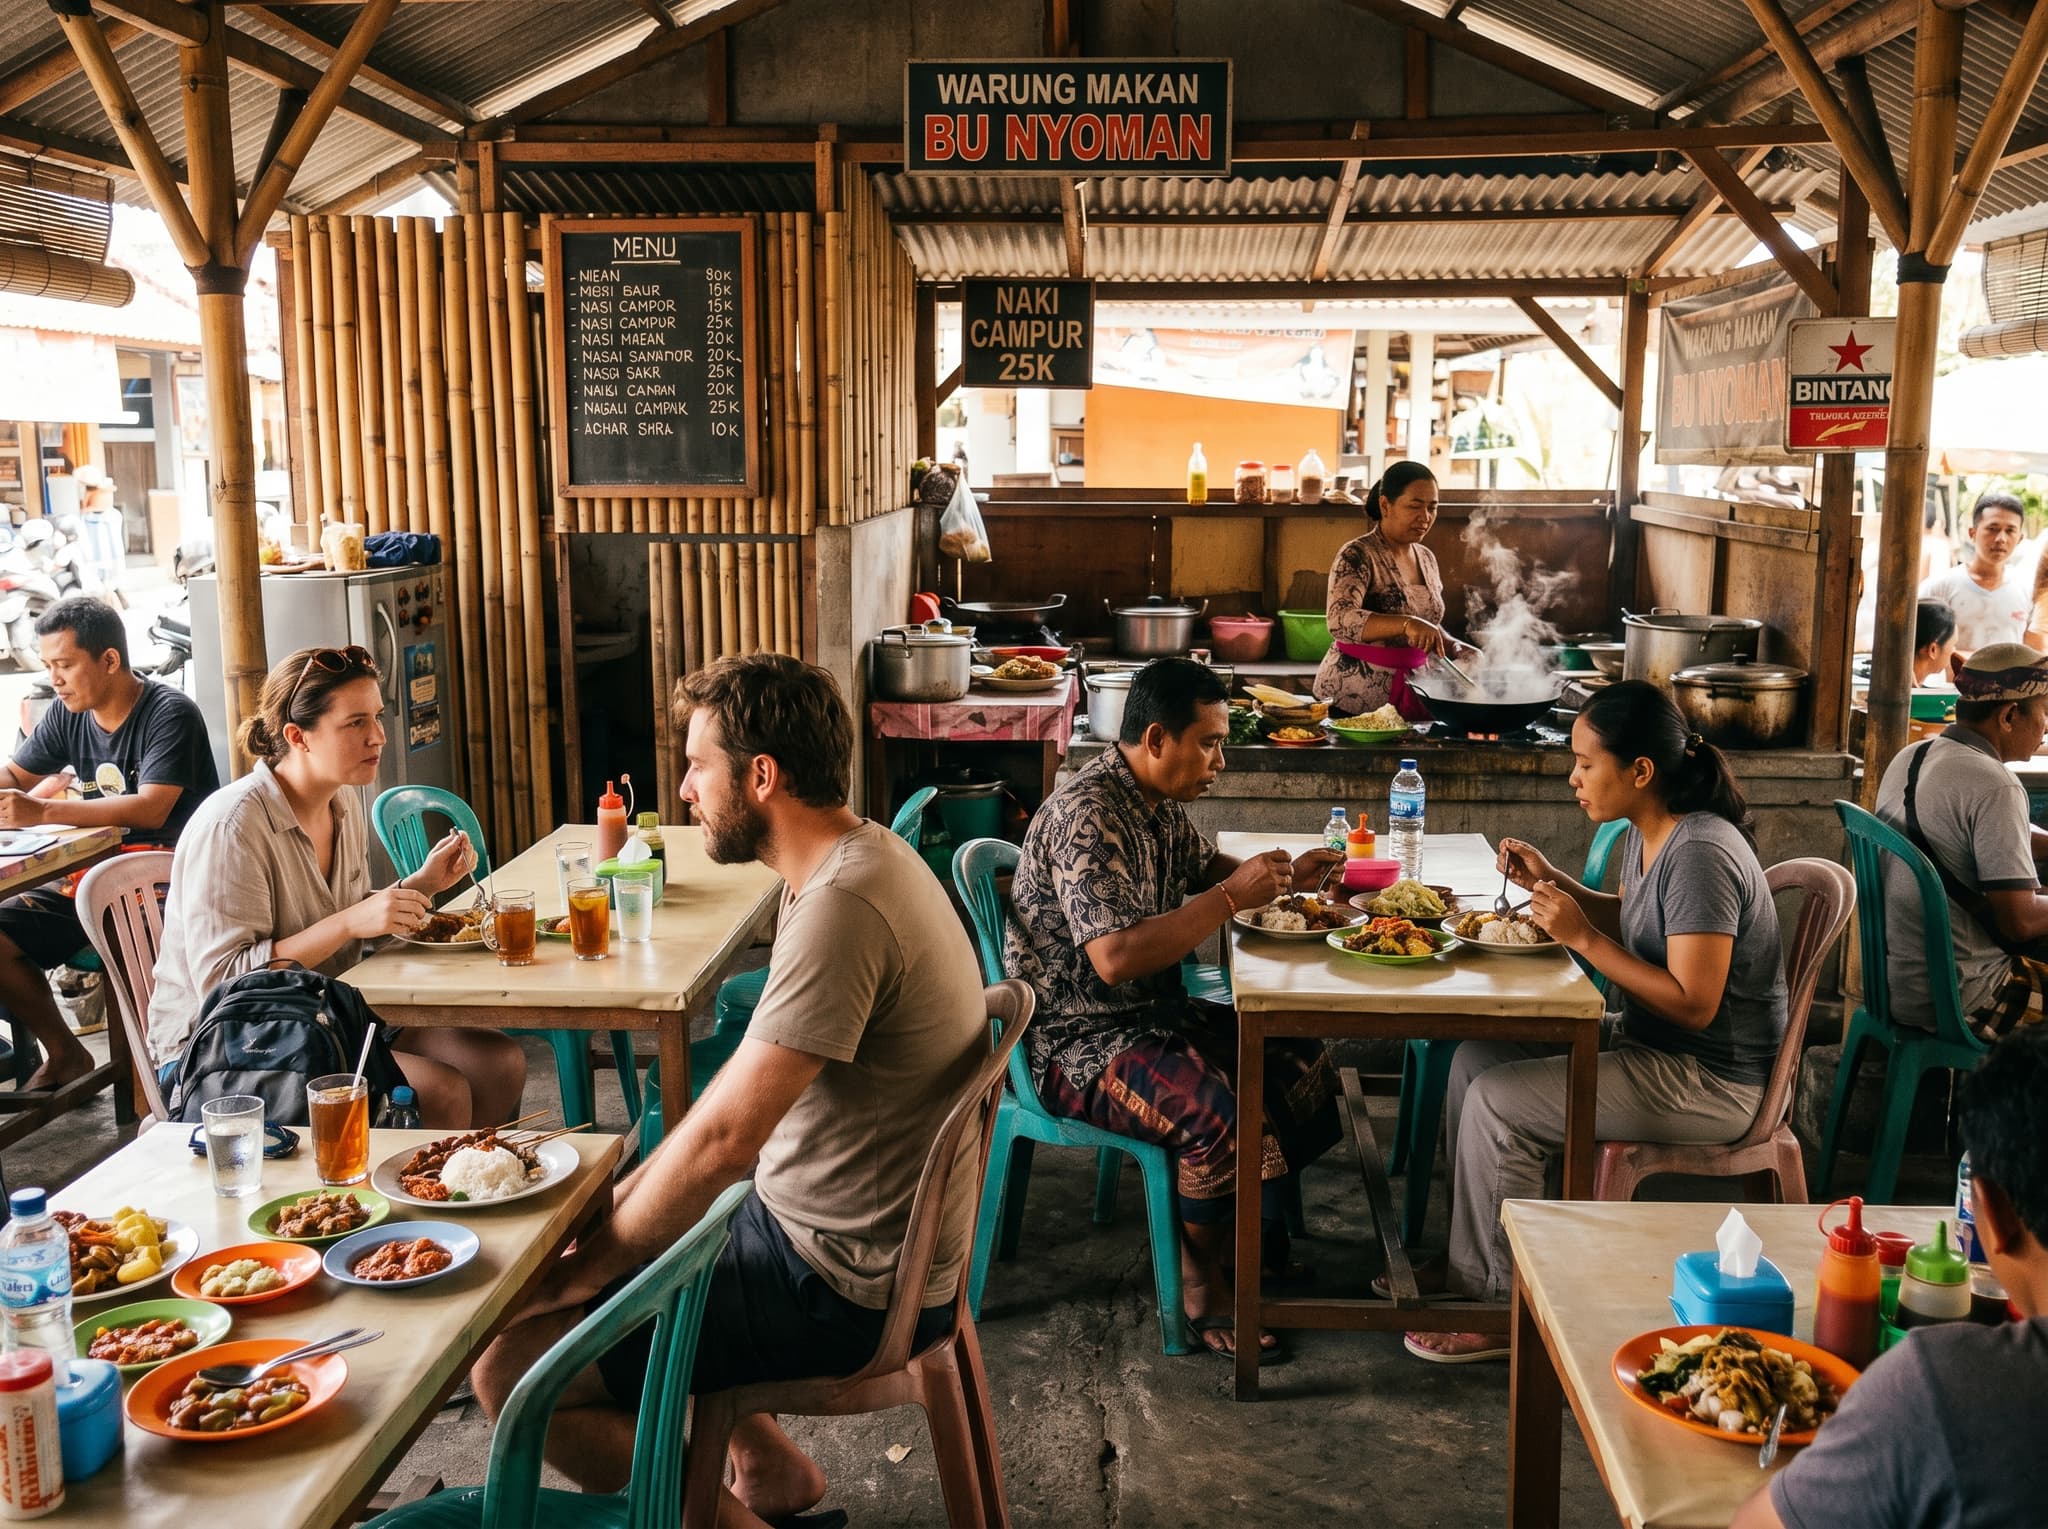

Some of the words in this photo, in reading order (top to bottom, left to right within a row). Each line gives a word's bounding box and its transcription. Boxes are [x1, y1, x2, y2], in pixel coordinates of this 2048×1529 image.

[938, 74, 1076, 104] WARUNG
[1087, 74, 1199, 104] MAKAN
[924, 113, 989, 161] BU
[1005, 113, 1212, 162] NYOMAN
[613, 237, 676, 258] MENU
[581, 301, 612, 313] NASI
[619, 300, 676, 312] CAMPOR
[708, 298, 733, 312] 15K
[997, 287, 1059, 314] NAKI
[581, 317, 612, 330] NASI
[619, 316, 676, 329] CAMPUR
[706, 315, 733, 329] 25K
[582, 333, 613, 346] NASI
[706, 331, 734, 345] 20K
[970, 319, 1083, 349] CAMPUR
[1684, 321, 1731, 361] WARUNG
[1733, 308, 1779, 350] MAKAN
[583, 350, 622, 363] NASAI
[707, 364, 734, 379] 25K
[998, 353, 1055, 380] 25K
[707, 382, 734, 397] 20K
[709, 400, 740, 414] 25K
[1672, 374, 1695, 428] BU
[584, 422, 629, 436] ACHAR
[711, 422, 740, 438] 10K
